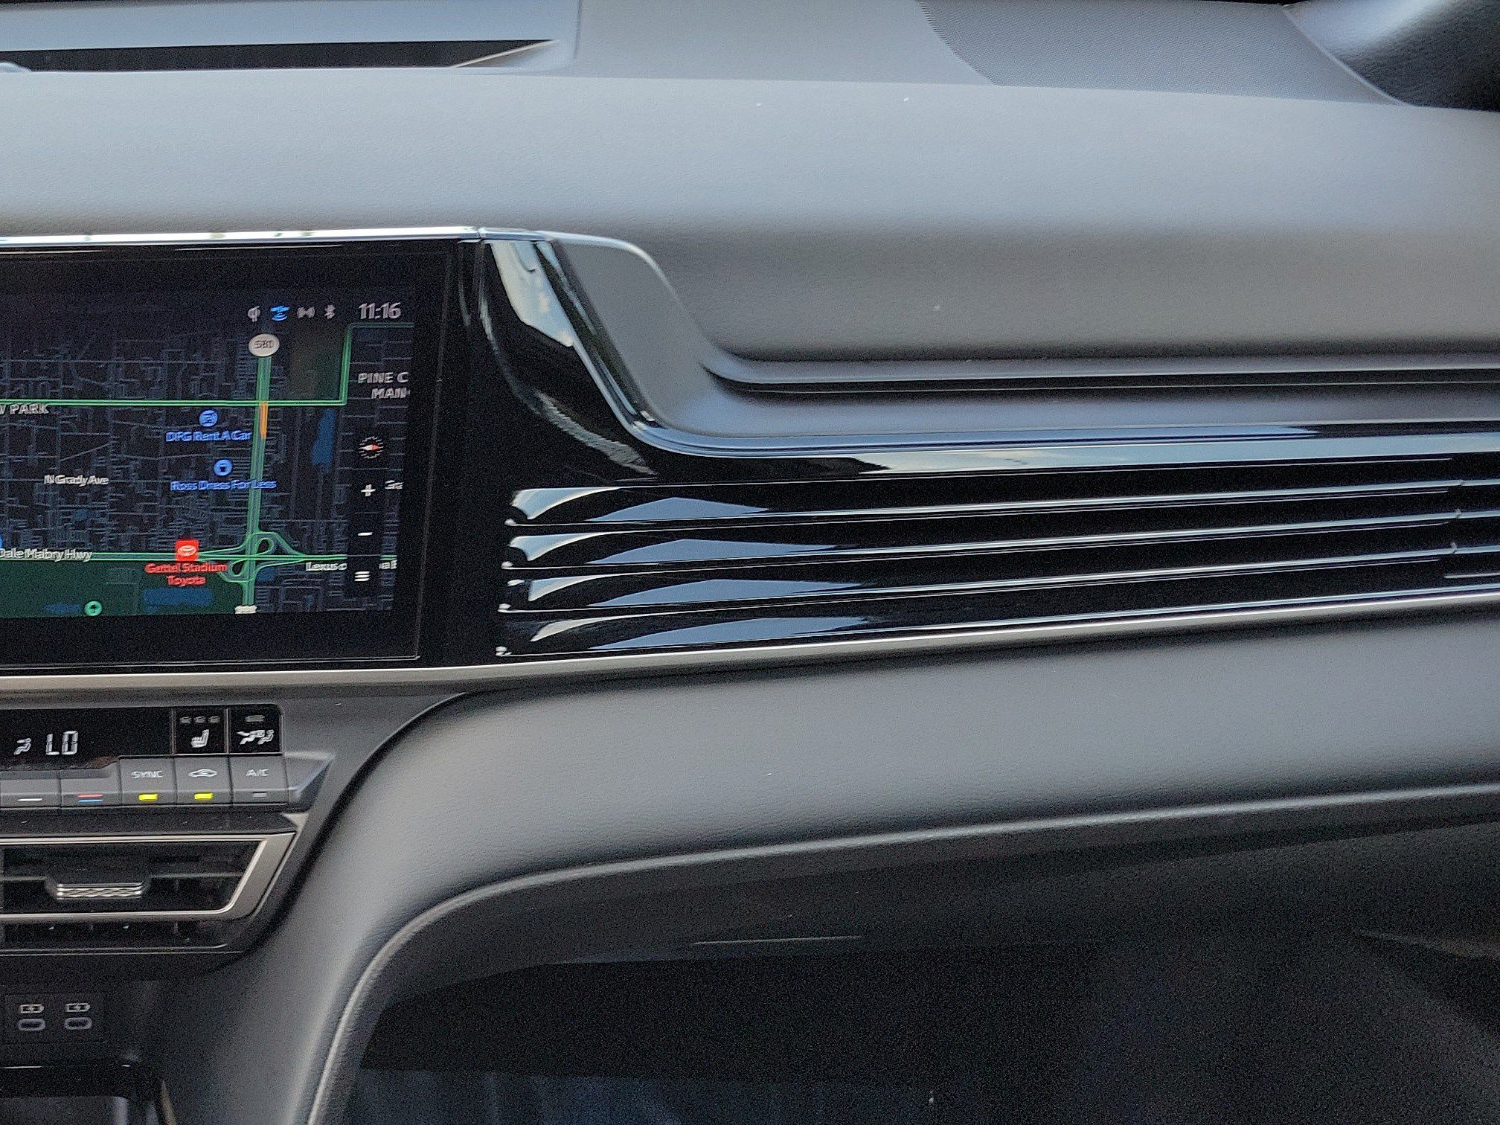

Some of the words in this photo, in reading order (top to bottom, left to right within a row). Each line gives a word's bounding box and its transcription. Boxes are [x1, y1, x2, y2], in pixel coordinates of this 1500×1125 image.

[358, 302, 401, 319] 11:16
[358, 372, 393, 383] PINE
[10, 403, 49, 415] PARK
[231, 430, 253, 440] Car
[87, 475, 109, 485] Ave
[24, 547, 65, 562] Mabry
[66, 549, 92, 562] Hwy
[182, 562, 228, 573] Stadium
[166, 575, 206, 586] Toyota
[131, 769, 163, 779] SYNC
[246, 768, 269, 777] A/C
